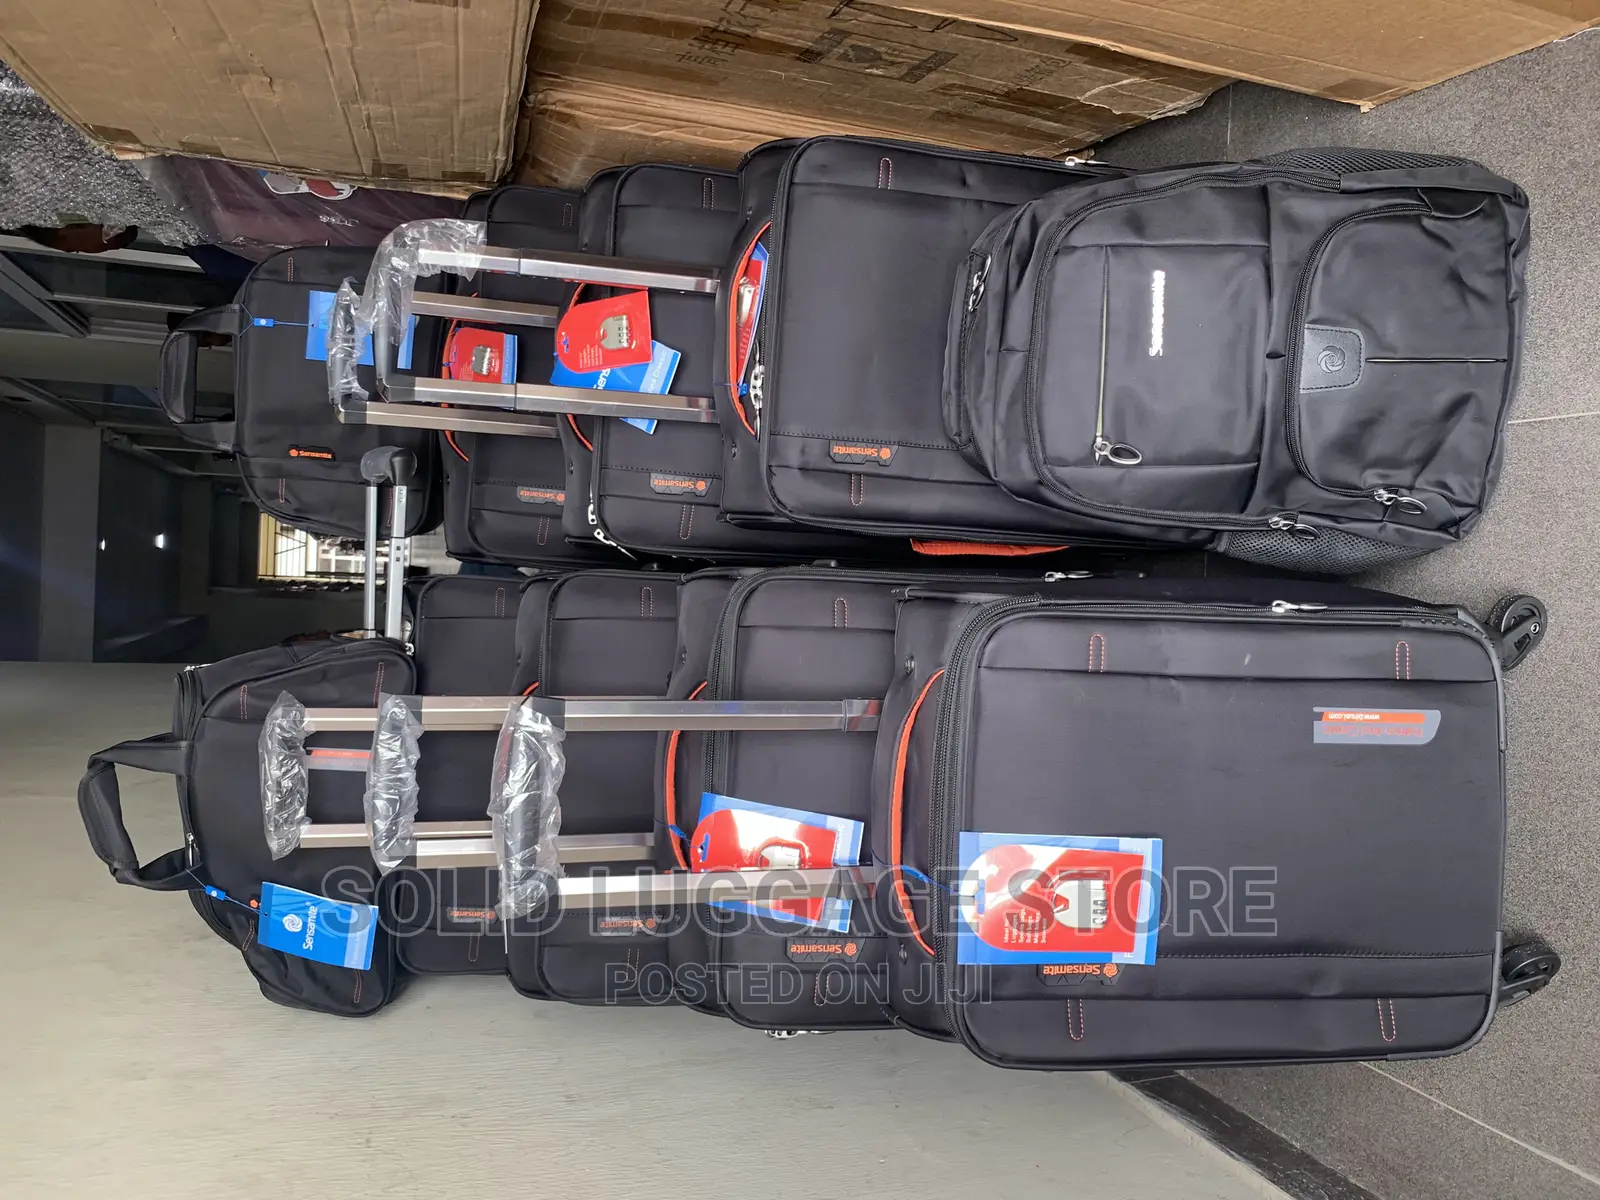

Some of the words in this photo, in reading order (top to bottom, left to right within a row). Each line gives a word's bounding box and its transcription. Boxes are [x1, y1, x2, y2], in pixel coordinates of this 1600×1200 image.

[832, 445, 878, 457] Sensamite
[653, 479, 694, 489] Sensamite
[520, 490, 555, 500] Sensamite
[302, 905, 318, 950] Sensamite
[790, 944, 842, 954] Sensamite
[1043, 964, 1101, 976] Sensamite
